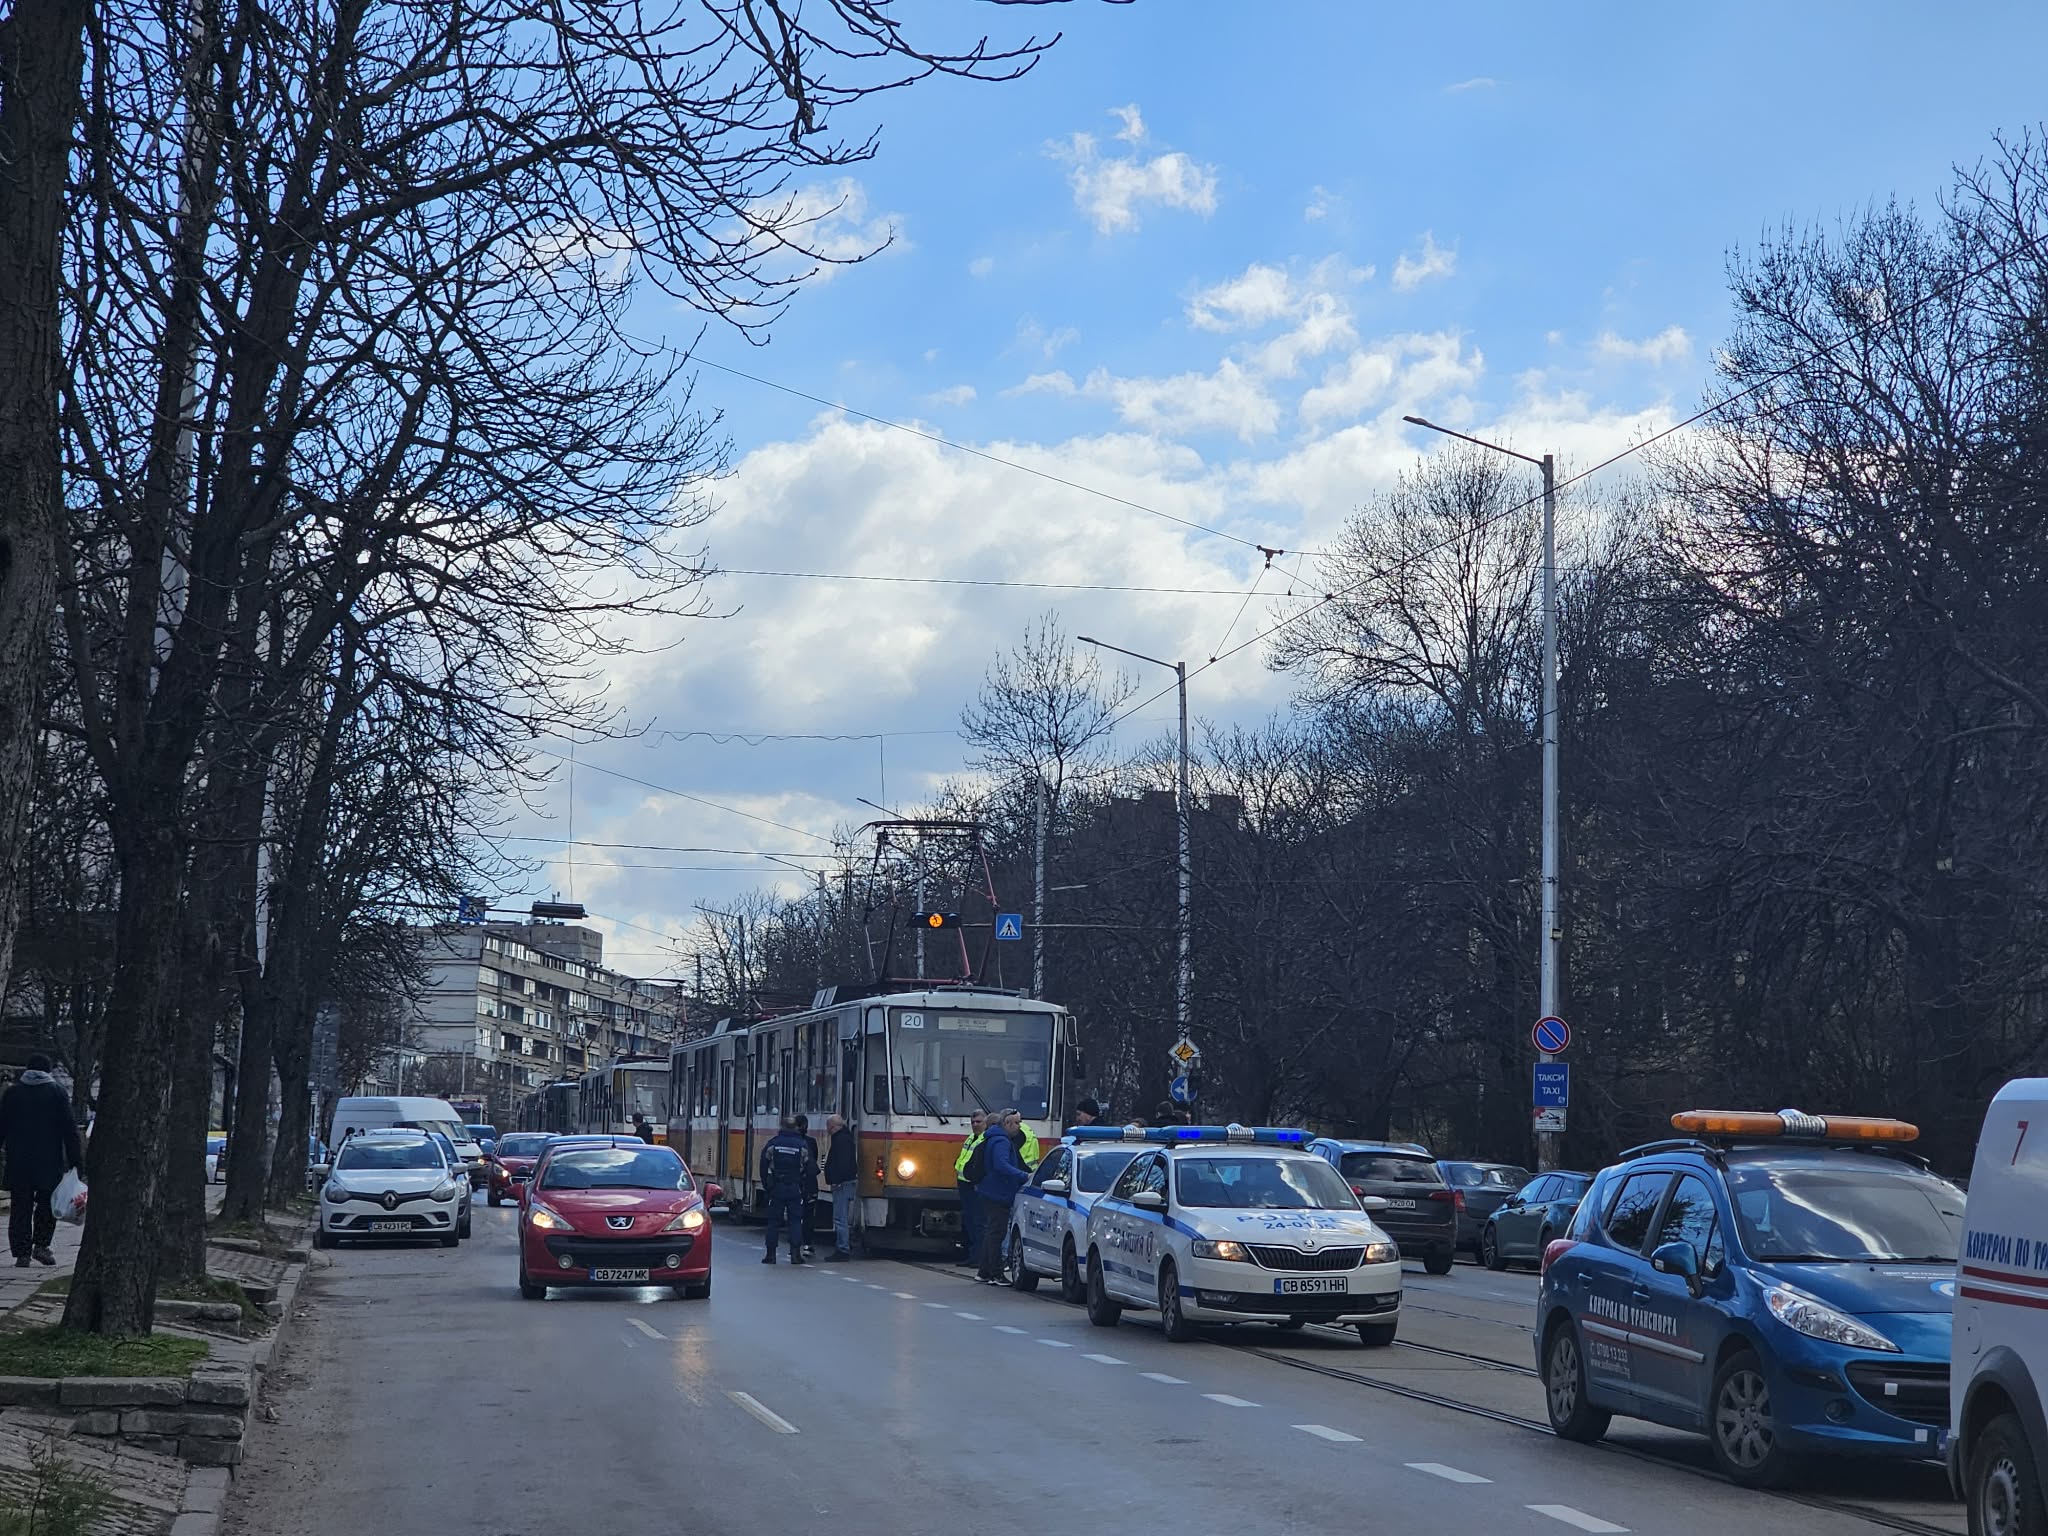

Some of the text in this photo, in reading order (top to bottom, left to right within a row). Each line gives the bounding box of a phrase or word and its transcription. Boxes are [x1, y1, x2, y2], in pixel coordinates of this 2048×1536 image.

[904, 1014, 921, 1026] 20
[1537, 1073, 1565, 1082] ТАКСИ
[1542, 1086, 1560, 1095] TAXI
[2011, 1120, 2029, 1166] 7
[2014, 1237, 2030, 1267] ПО
[596, 1270, 609, 1280] CB
[610, 1270, 633, 1280] 7247
[1283, 1279, 1345, 1293] CB 8591 HH
[1619, 1303, 1629, 1324] ПО
[1630, 1307, 1677, 1337] ТРАНСПОРТА
